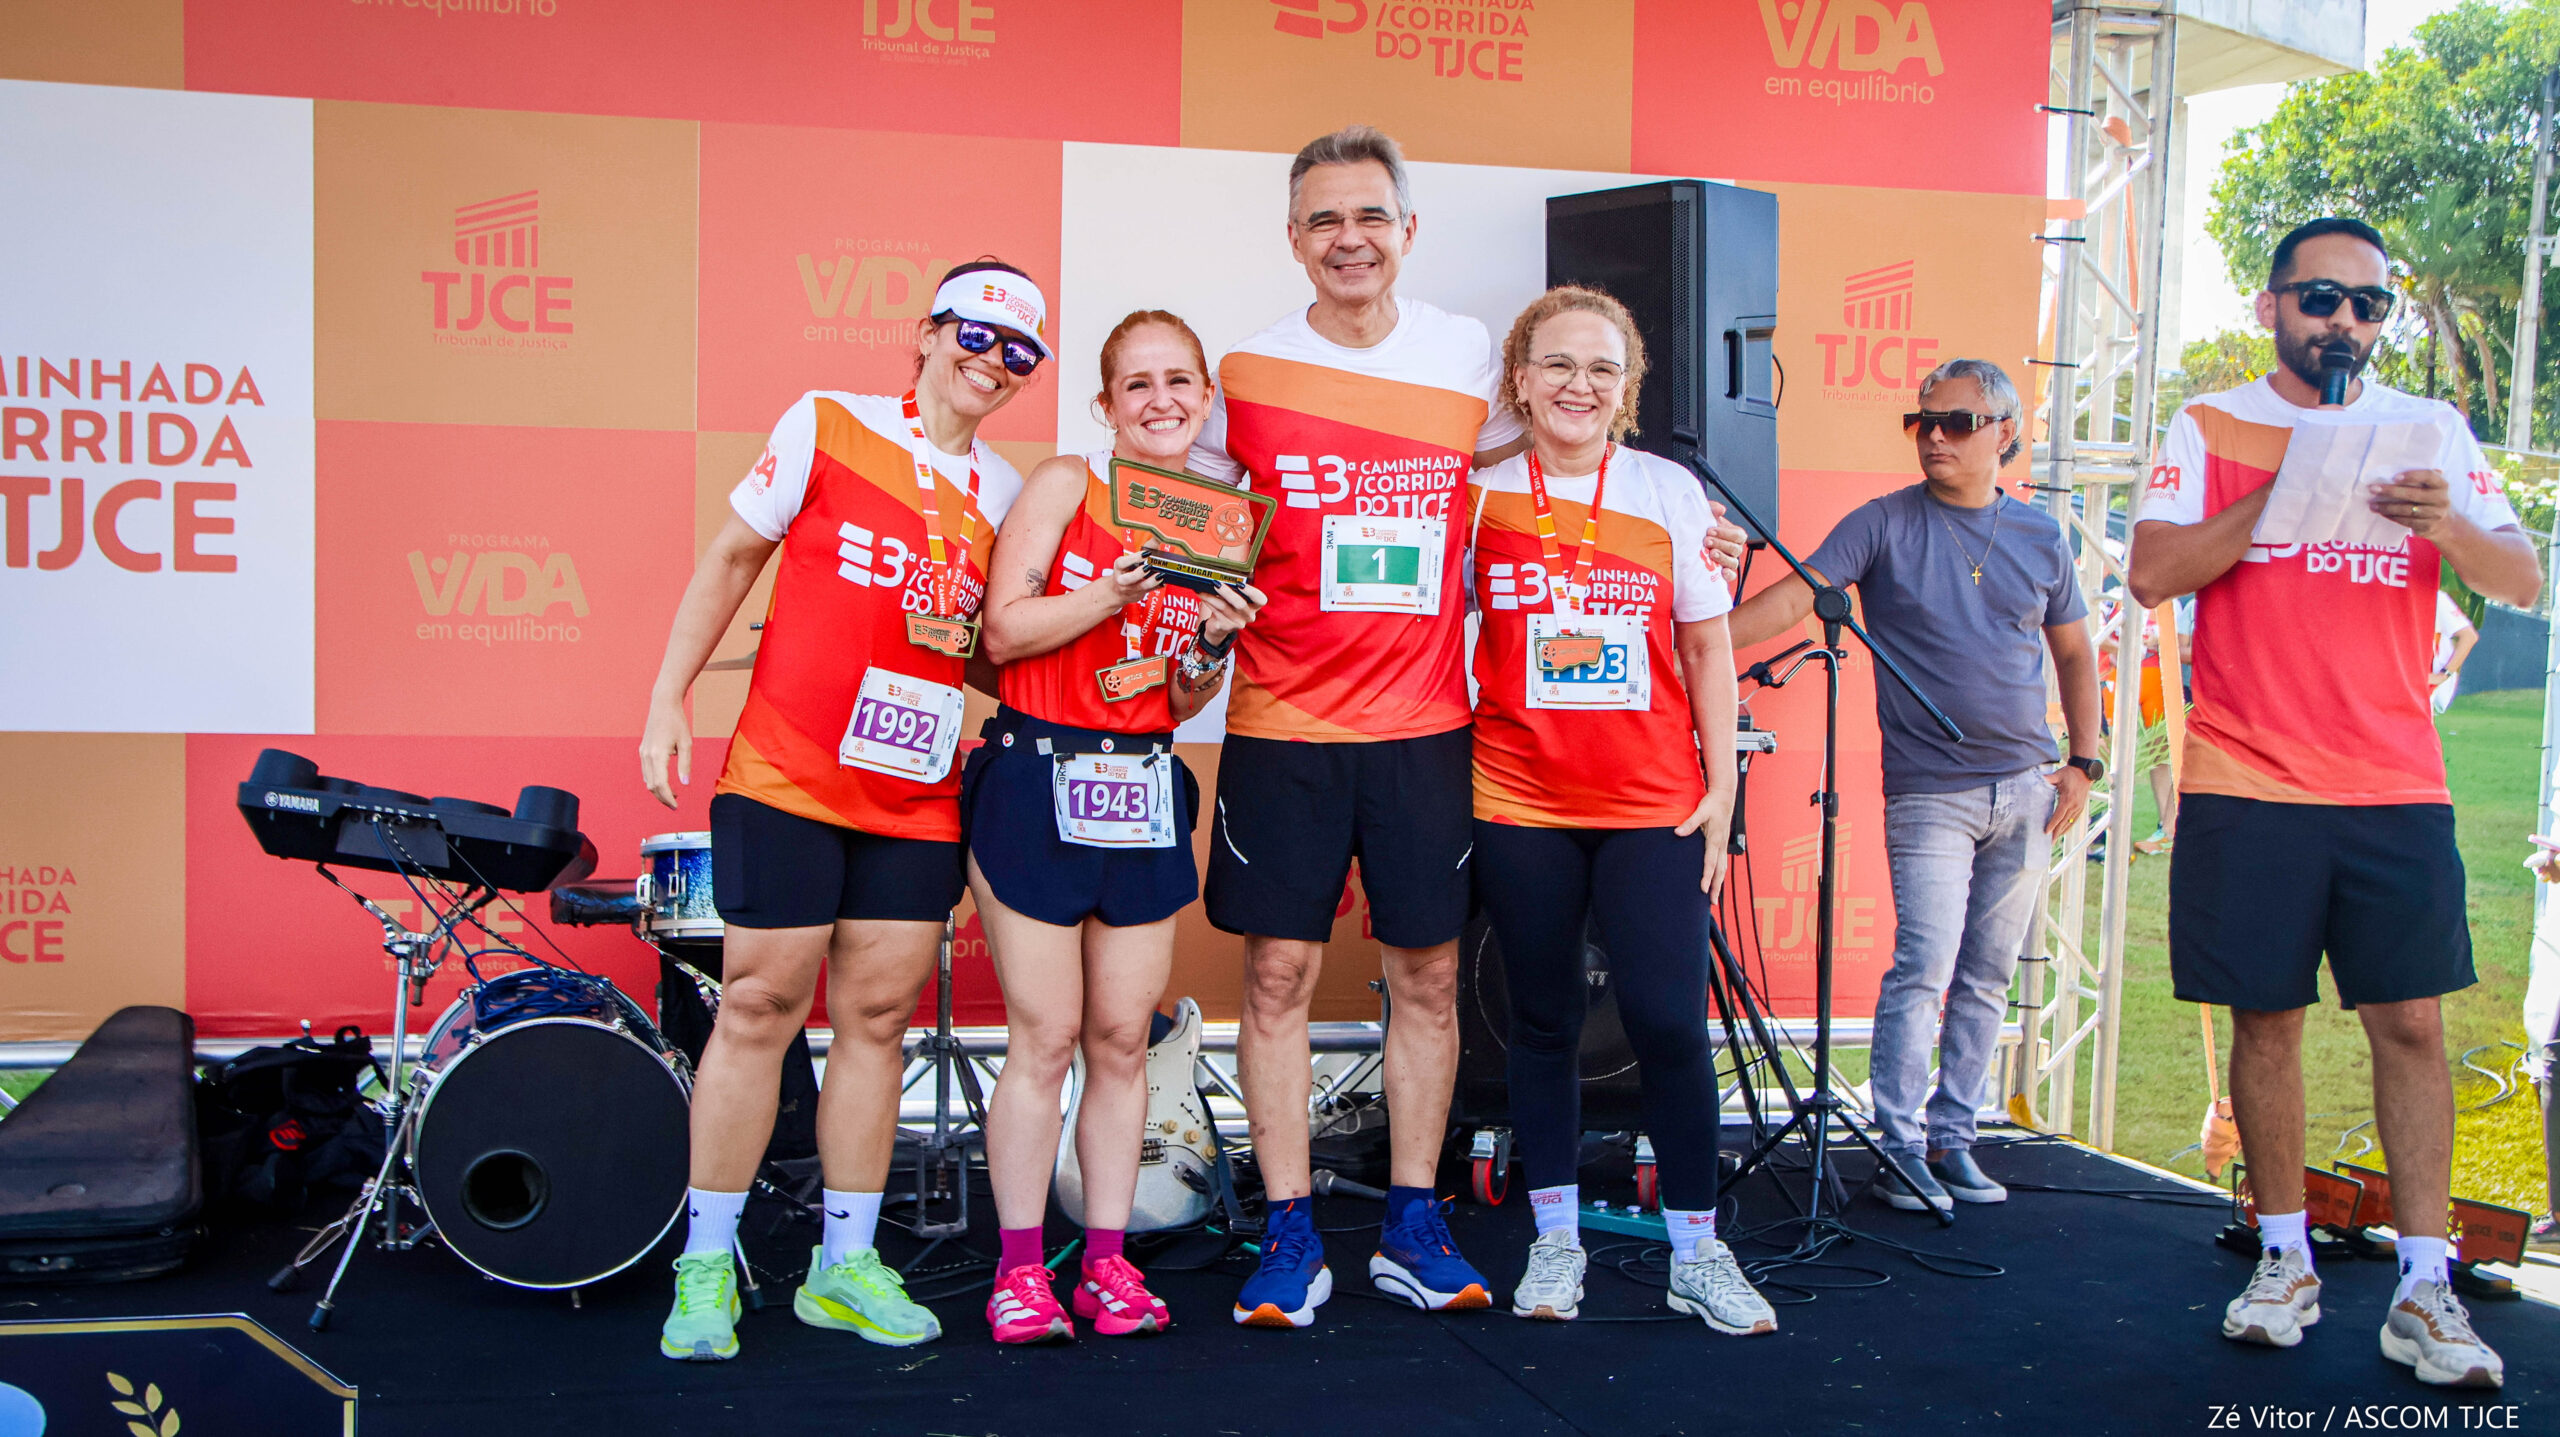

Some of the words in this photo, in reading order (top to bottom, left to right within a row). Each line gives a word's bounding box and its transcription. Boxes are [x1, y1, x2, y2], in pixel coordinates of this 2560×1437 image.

[1375, 2, 1530, 37] /CORRIDA
[862, 38, 919, 53] Tribunal
[922, 43, 940, 55] de
[944, 44, 991, 59] Justiça
[1758, 0, 1945, 76] VIDA
[1375, 30, 1422, 60] DO
[1427, 36, 1523, 82] TJCE
[1765, 76, 1801, 96] em
[1808, 74, 1934, 106] equilíbrio
[835, 238, 932, 253] PROGRAMA
[421, 271, 574, 334] TJCE
[433, 332, 492, 347] Tribunal
[496, 336, 515, 347] de
[519, 336, 568, 351] Justiça
[803, 324, 838, 343] em
[1815, 333, 1939, 390] TJCE
[1821, 389, 1870, 402] Tribunal
[1874, 391, 1889, 402] de
[1360, 455, 1462, 475] CAMINHADA
[1355, 472, 1457, 494] /CORRIDA
[1355, 496, 1389, 516] DO
[0, 475, 238, 573] TJCE
[1158, 507, 1175, 519] DO
[1175, 511, 1207, 532] TJCE
[448, 533, 551, 548] PROGRAMA
[1326, 530, 1334, 550] 3KM
[1150, 556, 1169, 568] 10KM
[1187, 565, 1214, 578] LUGAR
[1371, 547, 1386, 581] 1
[2306, 552, 2341, 573] DO
[2345, 553, 2410, 588] TJCE
[407, 550, 590, 617] VIDA
[901, 588, 933, 615] DO
[416, 622, 452, 640] em
[458, 618, 581, 647] equilíbrio
[861, 701, 937, 751] 1992
[279, 793, 320, 813] YAMAHA
[1071, 782, 1147, 820] 1943
[0, 890, 71, 915] IDA
[477, 960, 519, 974] ustiça
[1760, 950, 1809, 962] Tribunal
